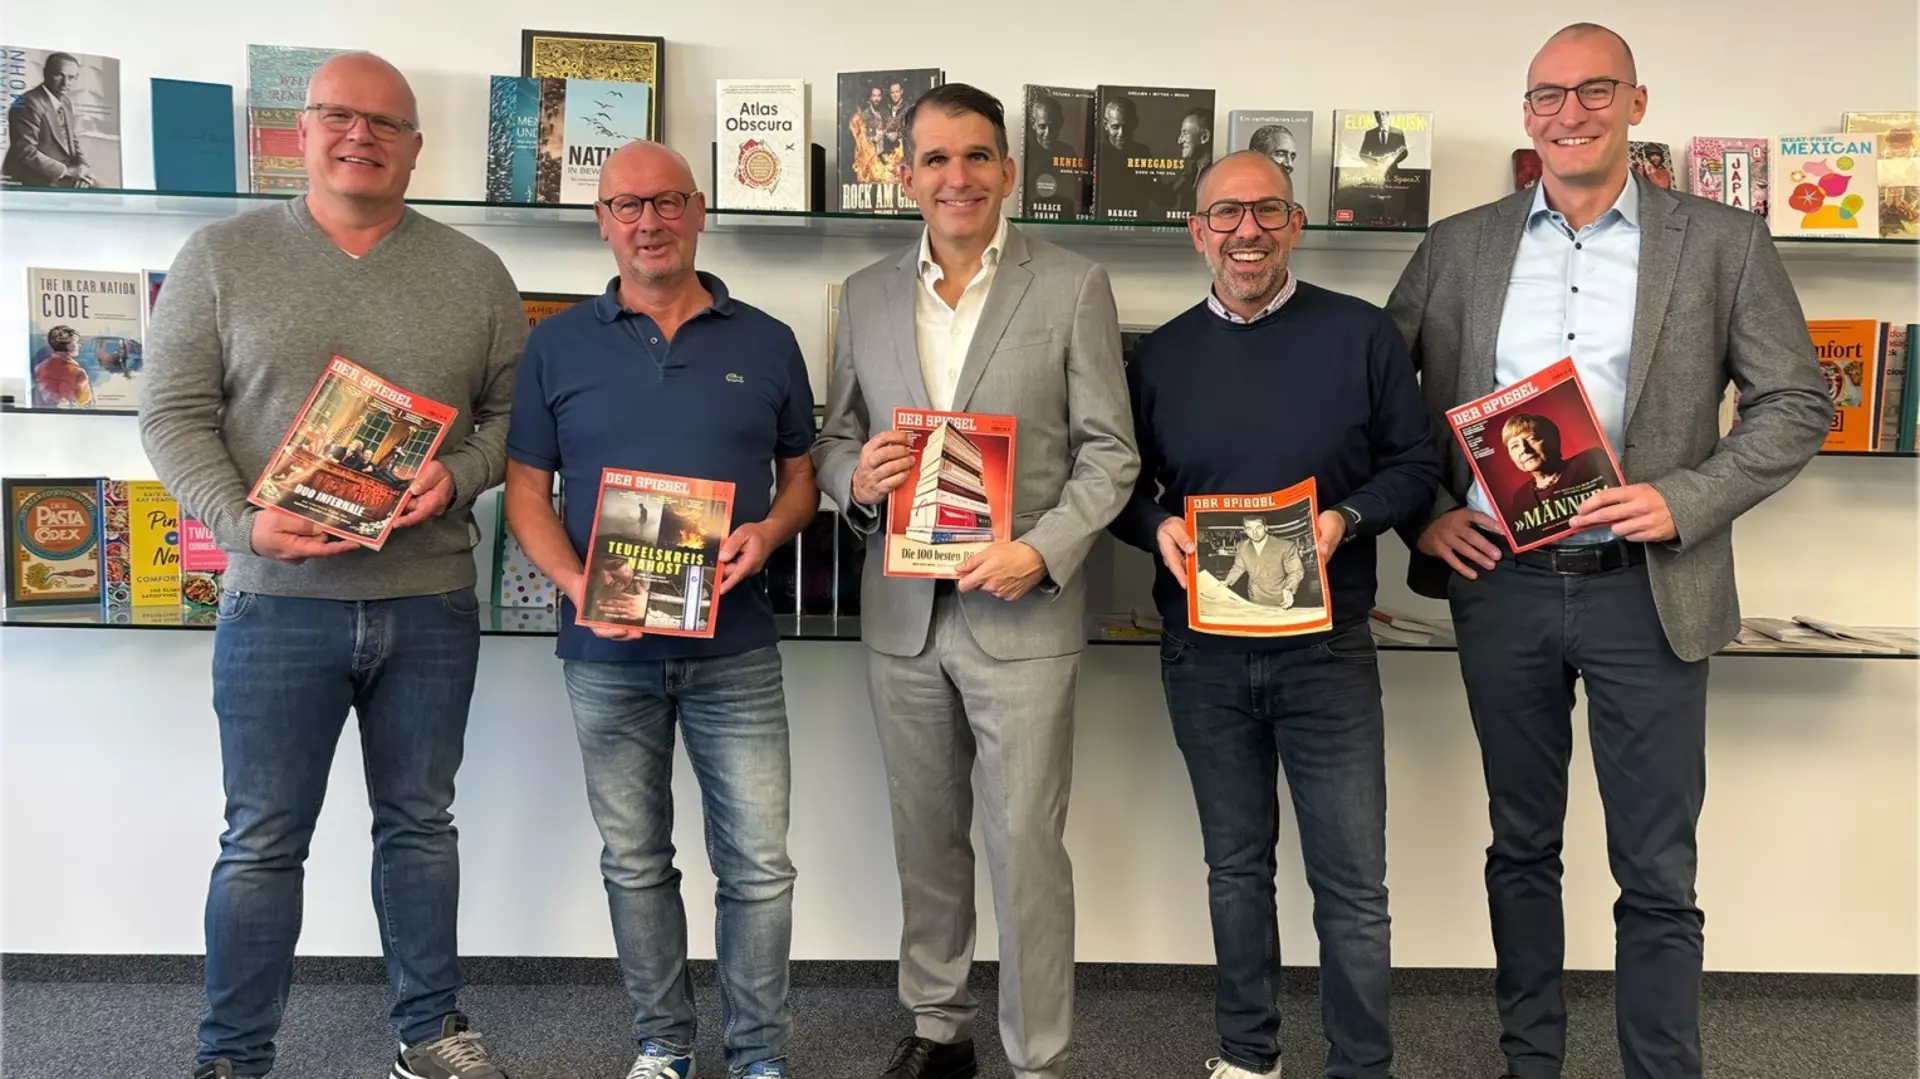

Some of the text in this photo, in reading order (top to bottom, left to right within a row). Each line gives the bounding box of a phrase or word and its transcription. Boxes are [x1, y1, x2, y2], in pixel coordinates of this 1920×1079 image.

[10, 49, 26, 108] MOHN
[740, 102, 778, 116] Atlas
[726, 118, 793, 131] Obscura
[1345, 113, 1425, 131] ELON MUSK
[1781, 142, 1872, 155] MEXICAN
[1127, 158, 1185, 169] RENEGADES
[1393, 175, 1421, 184] SpaceX
[842, 184, 873, 209] ROCK
[876, 184, 894, 208] AM
[1033, 203, 1062, 212] BARACK
[1034, 212, 1060, 220] OBAMA
[1107, 209, 1191, 219] BARACK BRUCE
[41, 278, 136, 295] THE IN.CAR.NATION
[43, 293, 90, 319] CODE
[331, 360, 359, 380] DER
[360, 375, 413, 408] SPIEGEL
[1452, 381, 1539, 425] DER SPIEGEL
[898, 412, 923, 426] DER
[604, 472, 690, 495] DER SPIEGEL
[293, 484, 317, 499] DUO
[315, 491, 366, 517] INFERNALE
[1194, 497, 1276, 509] DER SPIEGEL
[36, 505, 86, 527] PASTA
[147, 510, 178, 531] Pin
[35, 527, 81, 544] CODEX
[188, 526, 213, 540] TWO
[608, 541, 704, 566] TEUFELSKREIS
[902, 548, 915, 560] Die
[917, 549, 933, 559] 100
[935, 549, 961, 561] besten
[628, 557, 681, 575] NAHOST
